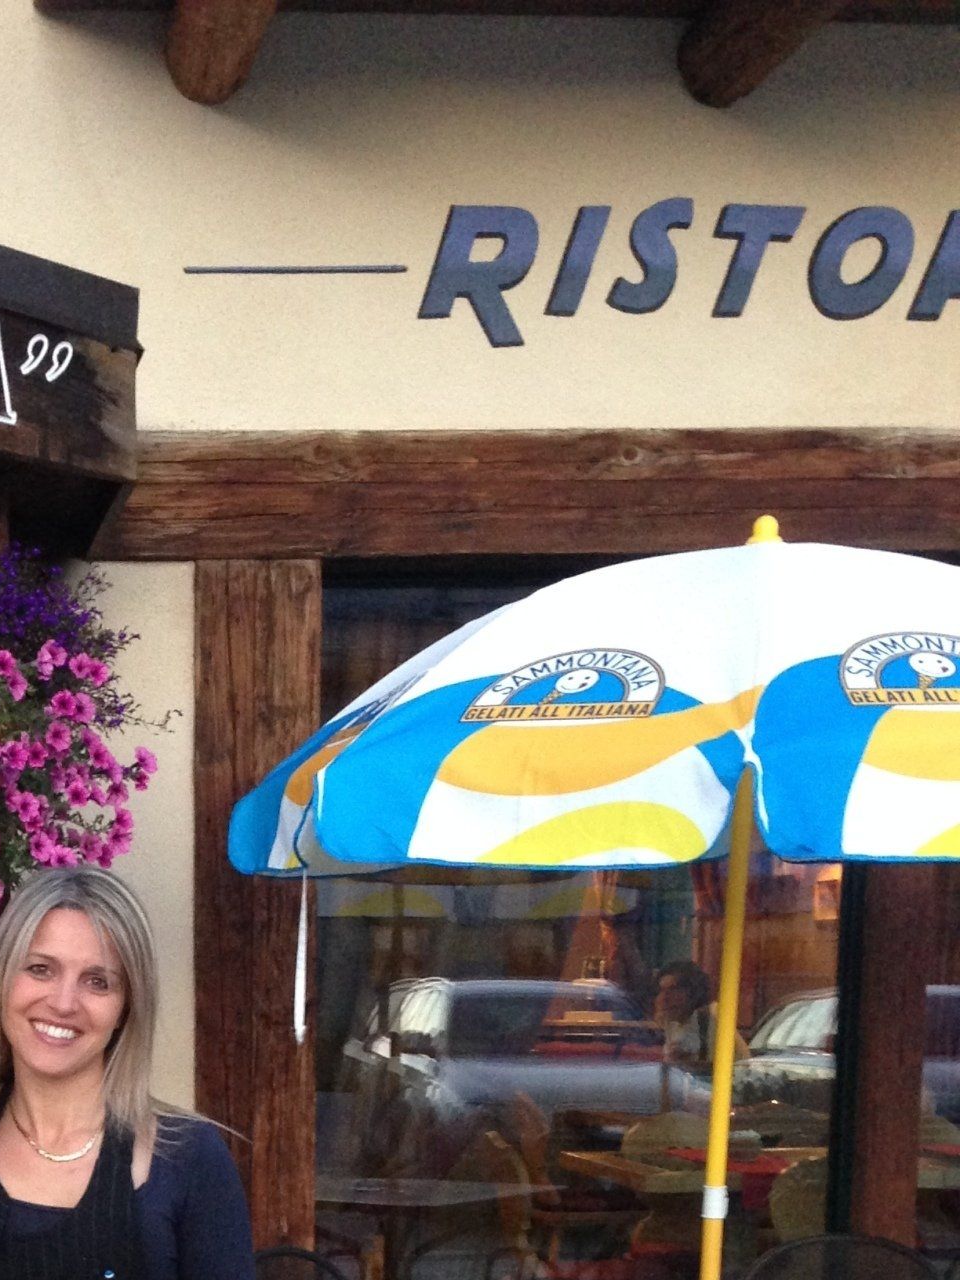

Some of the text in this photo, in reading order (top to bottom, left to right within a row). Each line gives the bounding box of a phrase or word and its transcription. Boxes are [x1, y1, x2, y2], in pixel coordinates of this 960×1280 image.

[492, 651, 658, 696] SAMMONTANA
[849, 690, 916, 703] GELATI
[464, 706, 524, 720] GELATI
